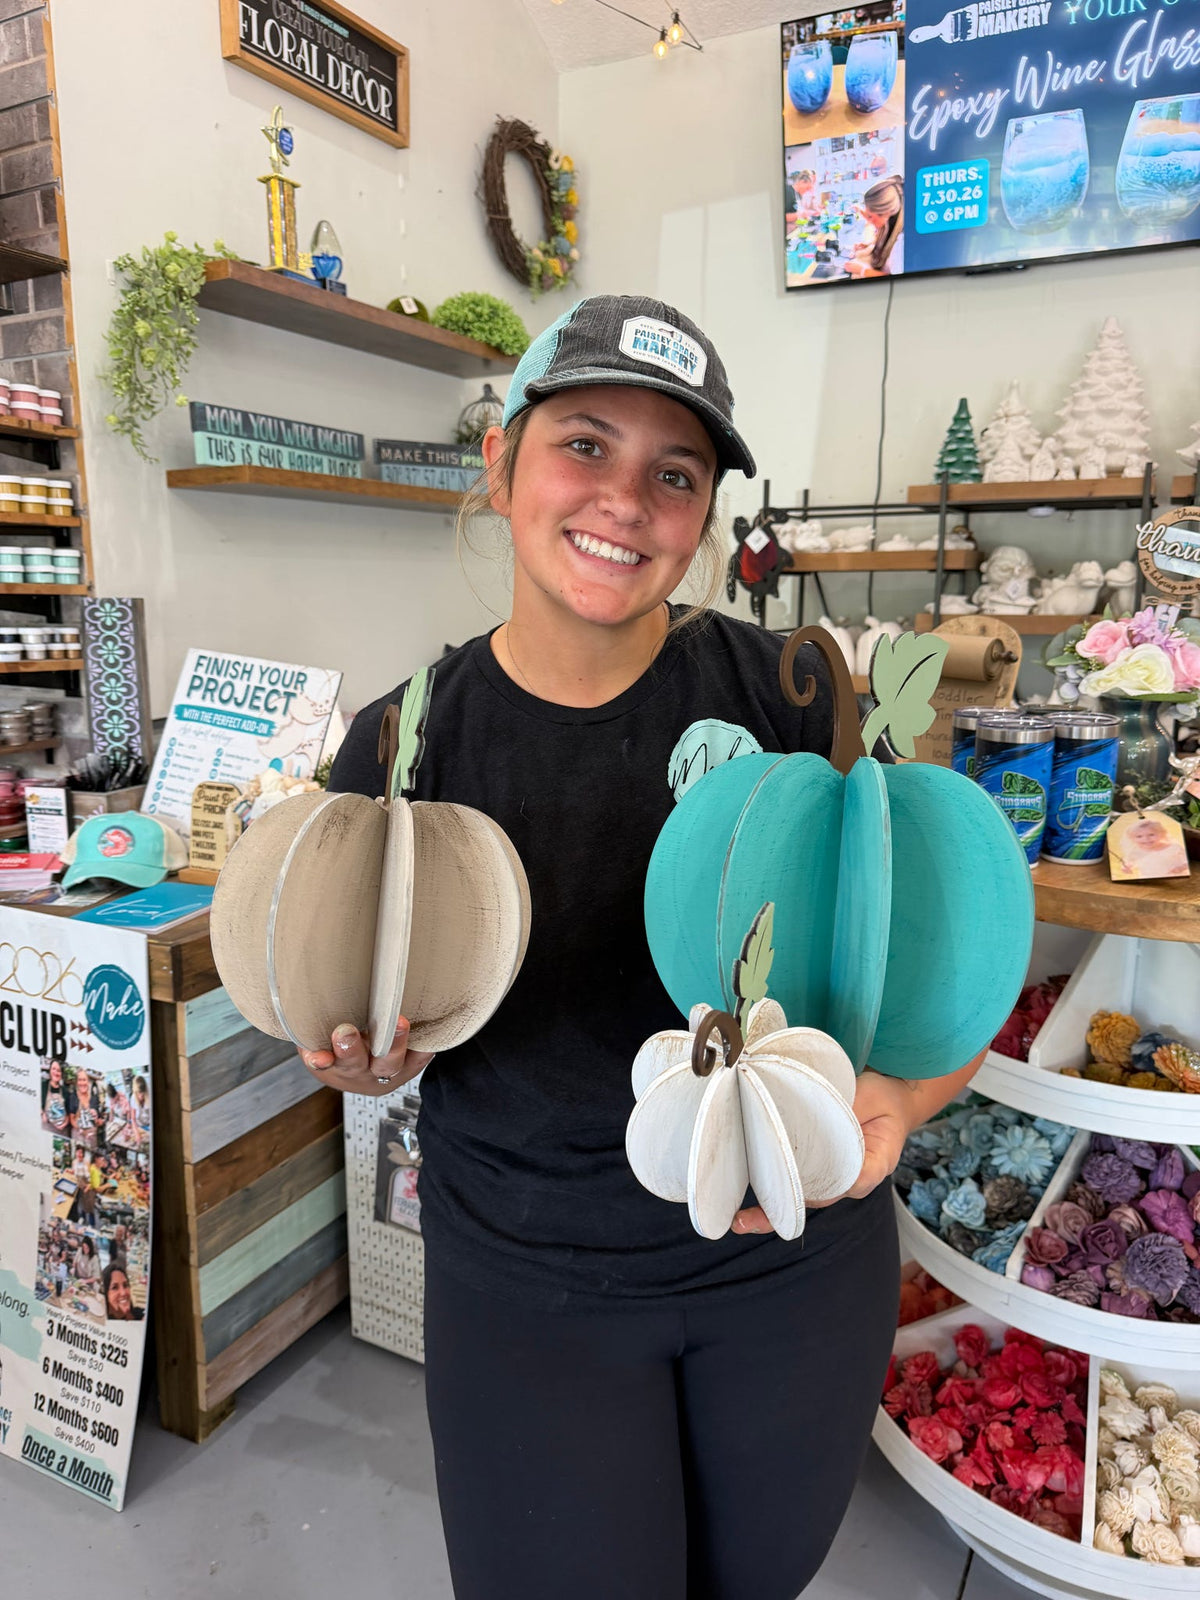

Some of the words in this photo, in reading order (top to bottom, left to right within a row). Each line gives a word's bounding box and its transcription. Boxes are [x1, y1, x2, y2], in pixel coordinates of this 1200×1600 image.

[272, 0, 315, 40] CREATE
[314, 22, 344, 57] YOUR
[344, 42, 370, 72] OWN
[978, 2, 1052, 38] MAKERY
[239, 1, 325, 84] FLORAL
[326, 52, 393, 122] DECOR
[908, 84, 1010, 151] Epoxy
[1014, 50, 1107, 109] Wine
[922, 166, 983, 188] THURS.
[922, 185, 983, 207] 7.30.26
[924, 210, 938, 224] @
[943, 204, 980, 222] 6PM
[632, 336, 698, 375] MAKERY
[634, 328, 671, 346] PAISLEY
[672, 340, 699, 363] GRACE
[249, 414, 279, 442] YOU
[258, 445, 284, 469] OUR
[380, 446, 423, 463] MAKE
[425, 450, 460, 465] THIS
[194, 654, 254, 682] FINISH
[259, 665, 308, 694] YOUR
[186, 674, 297, 717] PROJECT
[933, 687, 983, 704] oddler
[183, 707, 199, 721] WITH
[200, 711, 212, 723] THE
[212, 713, 242, 729] PERFECT
[241, 719, 270, 734] ADD-ON
[0, 942, 84, 1007] 2026
[84, 982, 144, 1024] Make
[0, 1001, 68, 1062] CLUB
[46, 1308, 65, 1322] Yearly
[65, 1314, 88, 1330] Project
[88, 1324, 106, 1339] Value
[106, 1332, 128, 1347] $1000
[46, 1319, 54, 1336] 3
[56, 1323, 98, 1355] Months
[100, 1343, 129, 1368] $225
[67, 1349, 87, 1366] Save
[87, 1357, 104, 1372] $30
[42, 1356, 50, 1374] 6
[51, 1360, 93, 1394] Months
[95, 1381, 124, 1408] $400
[60, 1387, 80, 1403] Save
[80, 1396, 101, 1414] $110
[33, 1392, 45, 1412] 12
[46, 1399, 88, 1433] Months
[90, 1420, 119, 1447] $600
[54, 1426, 74, 1443] Save
[74, 1436, 96, 1454] $400
[21, 1434, 56, 1468] Once
[57, 1455, 67, 1474] a
[67, 1457, 114, 1497] Month
